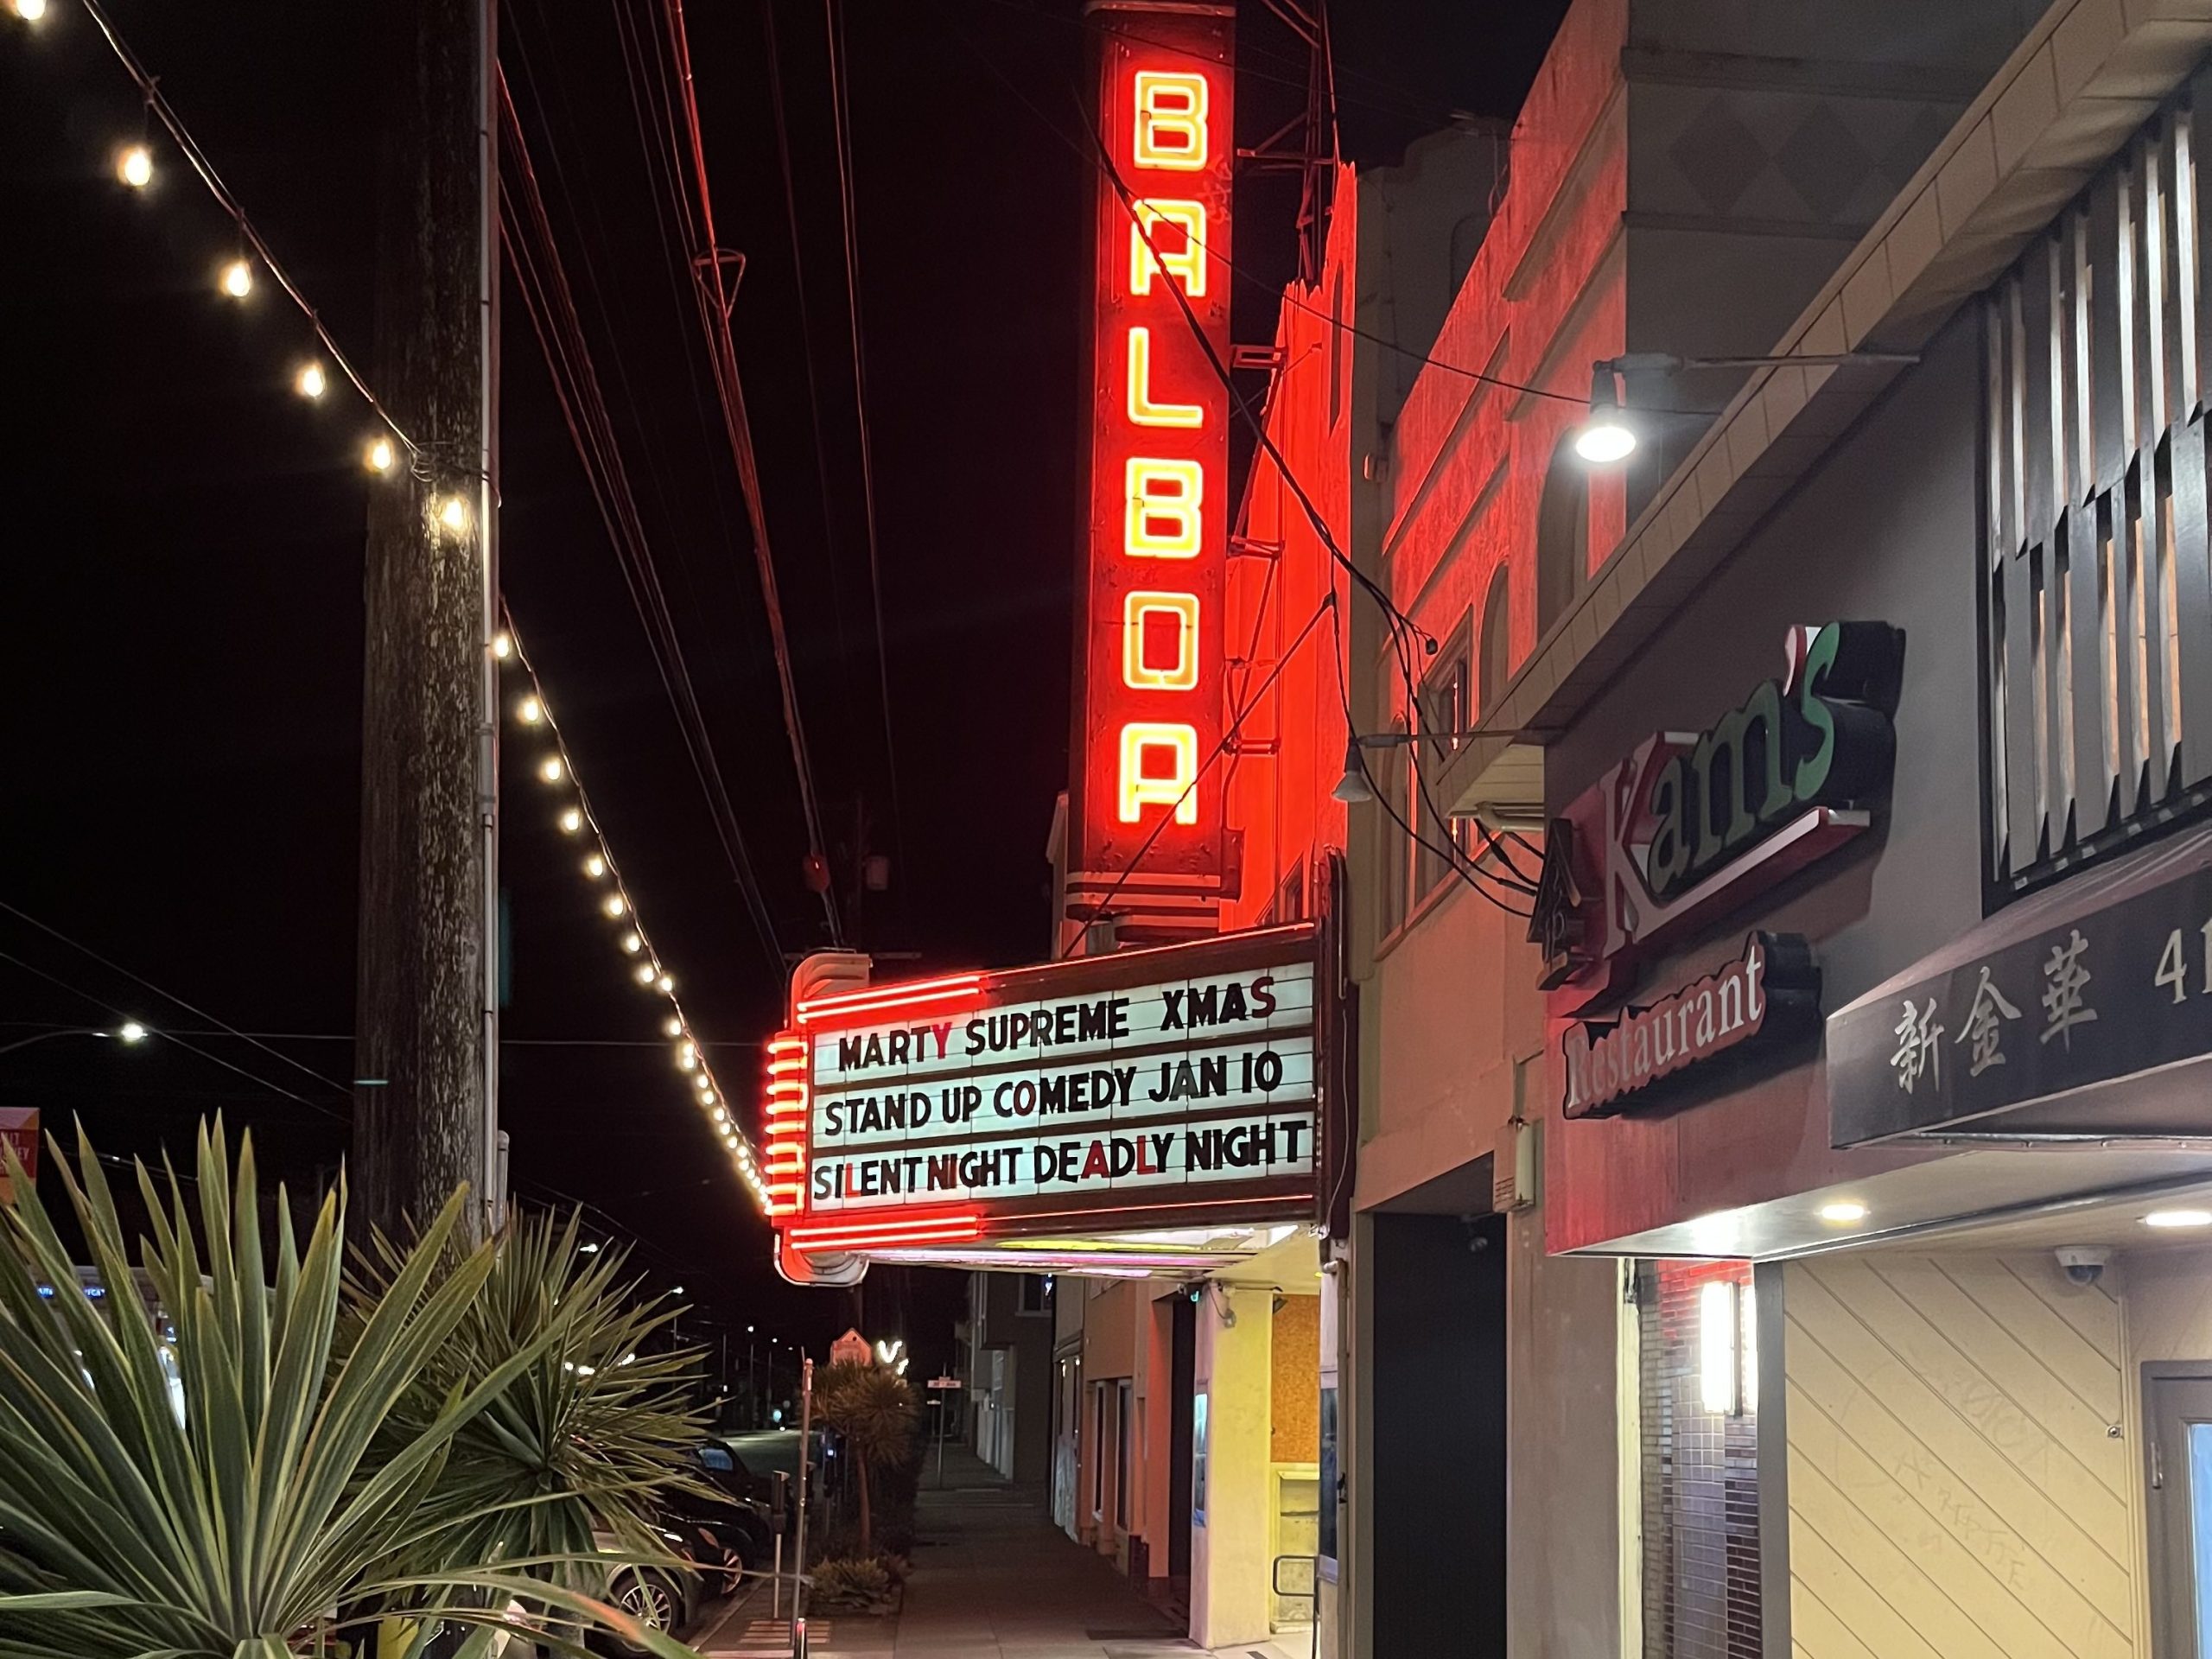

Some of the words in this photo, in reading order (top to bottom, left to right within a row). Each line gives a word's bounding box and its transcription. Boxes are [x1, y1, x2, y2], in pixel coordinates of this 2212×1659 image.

[1118, 71, 1210, 824] BALBOA
[1600, 621, 1840, 959] Kam's
[838, 1022, 953, 1071] MARTY
[965, 997, 1129, 1055] SUPREME
[1160, 976, 1276, 1031] XMAS
[1567, 945, 1763, 1109] Restaurant
[1890, 929, 2099, 1095] 新金華
[813, 1156, 922, 1200] SILENT
[927, 1147, 1024, 1191] NIGHT
[1033, 1130, 1175, 1184] DEADLY
[1185, 1120, 1307, 1173] NIGHT
[823, 1091, 931, 1137] STAND
[942, 1085, 982, 1125] UP
[993, 1065, 1137, 1117] COMEDY
[1147, 1055, 1228, 1103] JAN
